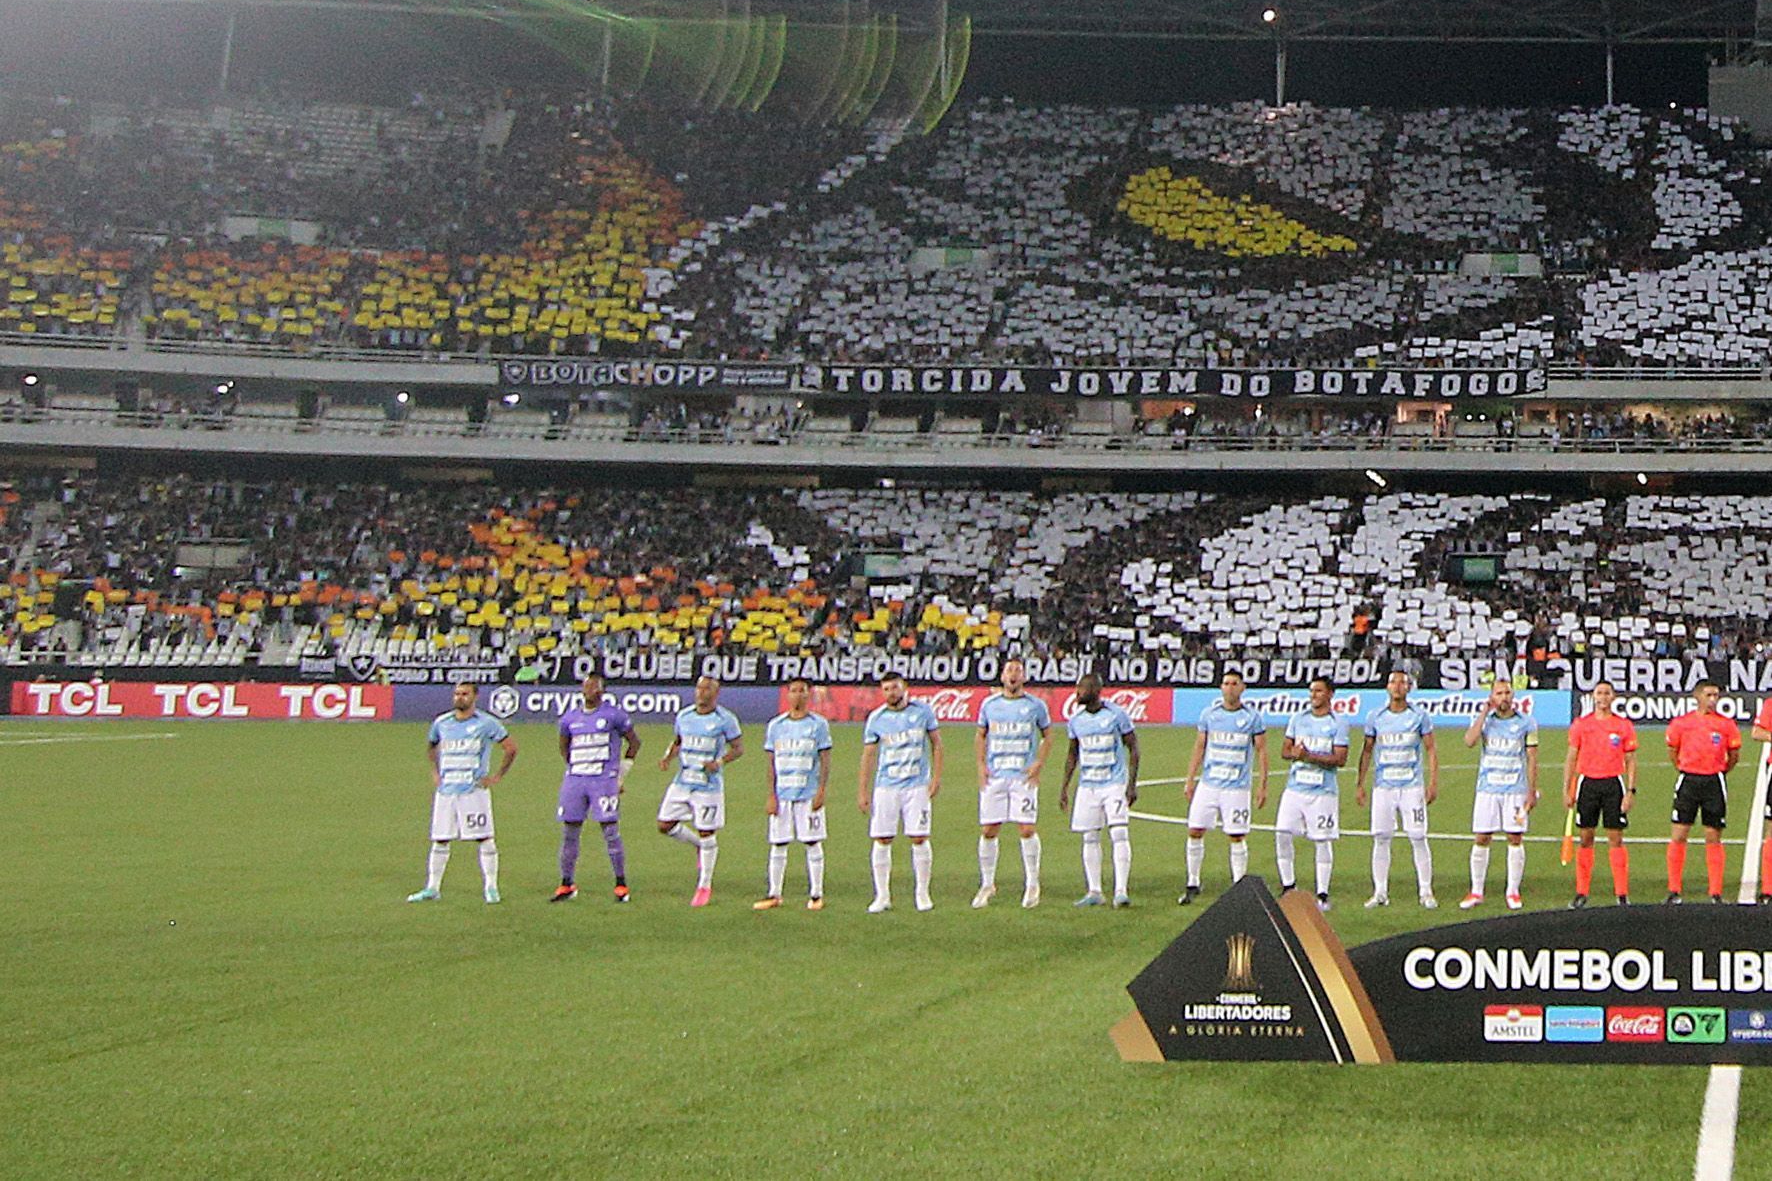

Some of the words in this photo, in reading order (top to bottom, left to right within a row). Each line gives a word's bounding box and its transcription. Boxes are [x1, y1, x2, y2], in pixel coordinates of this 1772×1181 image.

[831, 369, 1026, 393] TORCIDA
[1050, 370, 1198, 396] JOVEM
[1220, 372, 1271, 397] DO
[603, 654, 694, 680] CLUBE
[701, 655, 758, 681] QUE
[1109, 657, 1149, 683] NO
[28, 683, 124, 717] TCL
[153, 683, 250, 718] TCL
[279, 684, 377, 718] TCL
[599, 795, 619, 812] 99
[1232, 809, 1249, 823] 29
[466, 813, 488, 829] 50
[1317, 815, 1334, 829] 26
[1403, 948, 1678, 992] CONMEBOL
[1184, 1004, 1292, 1021] LIBERTADORES
